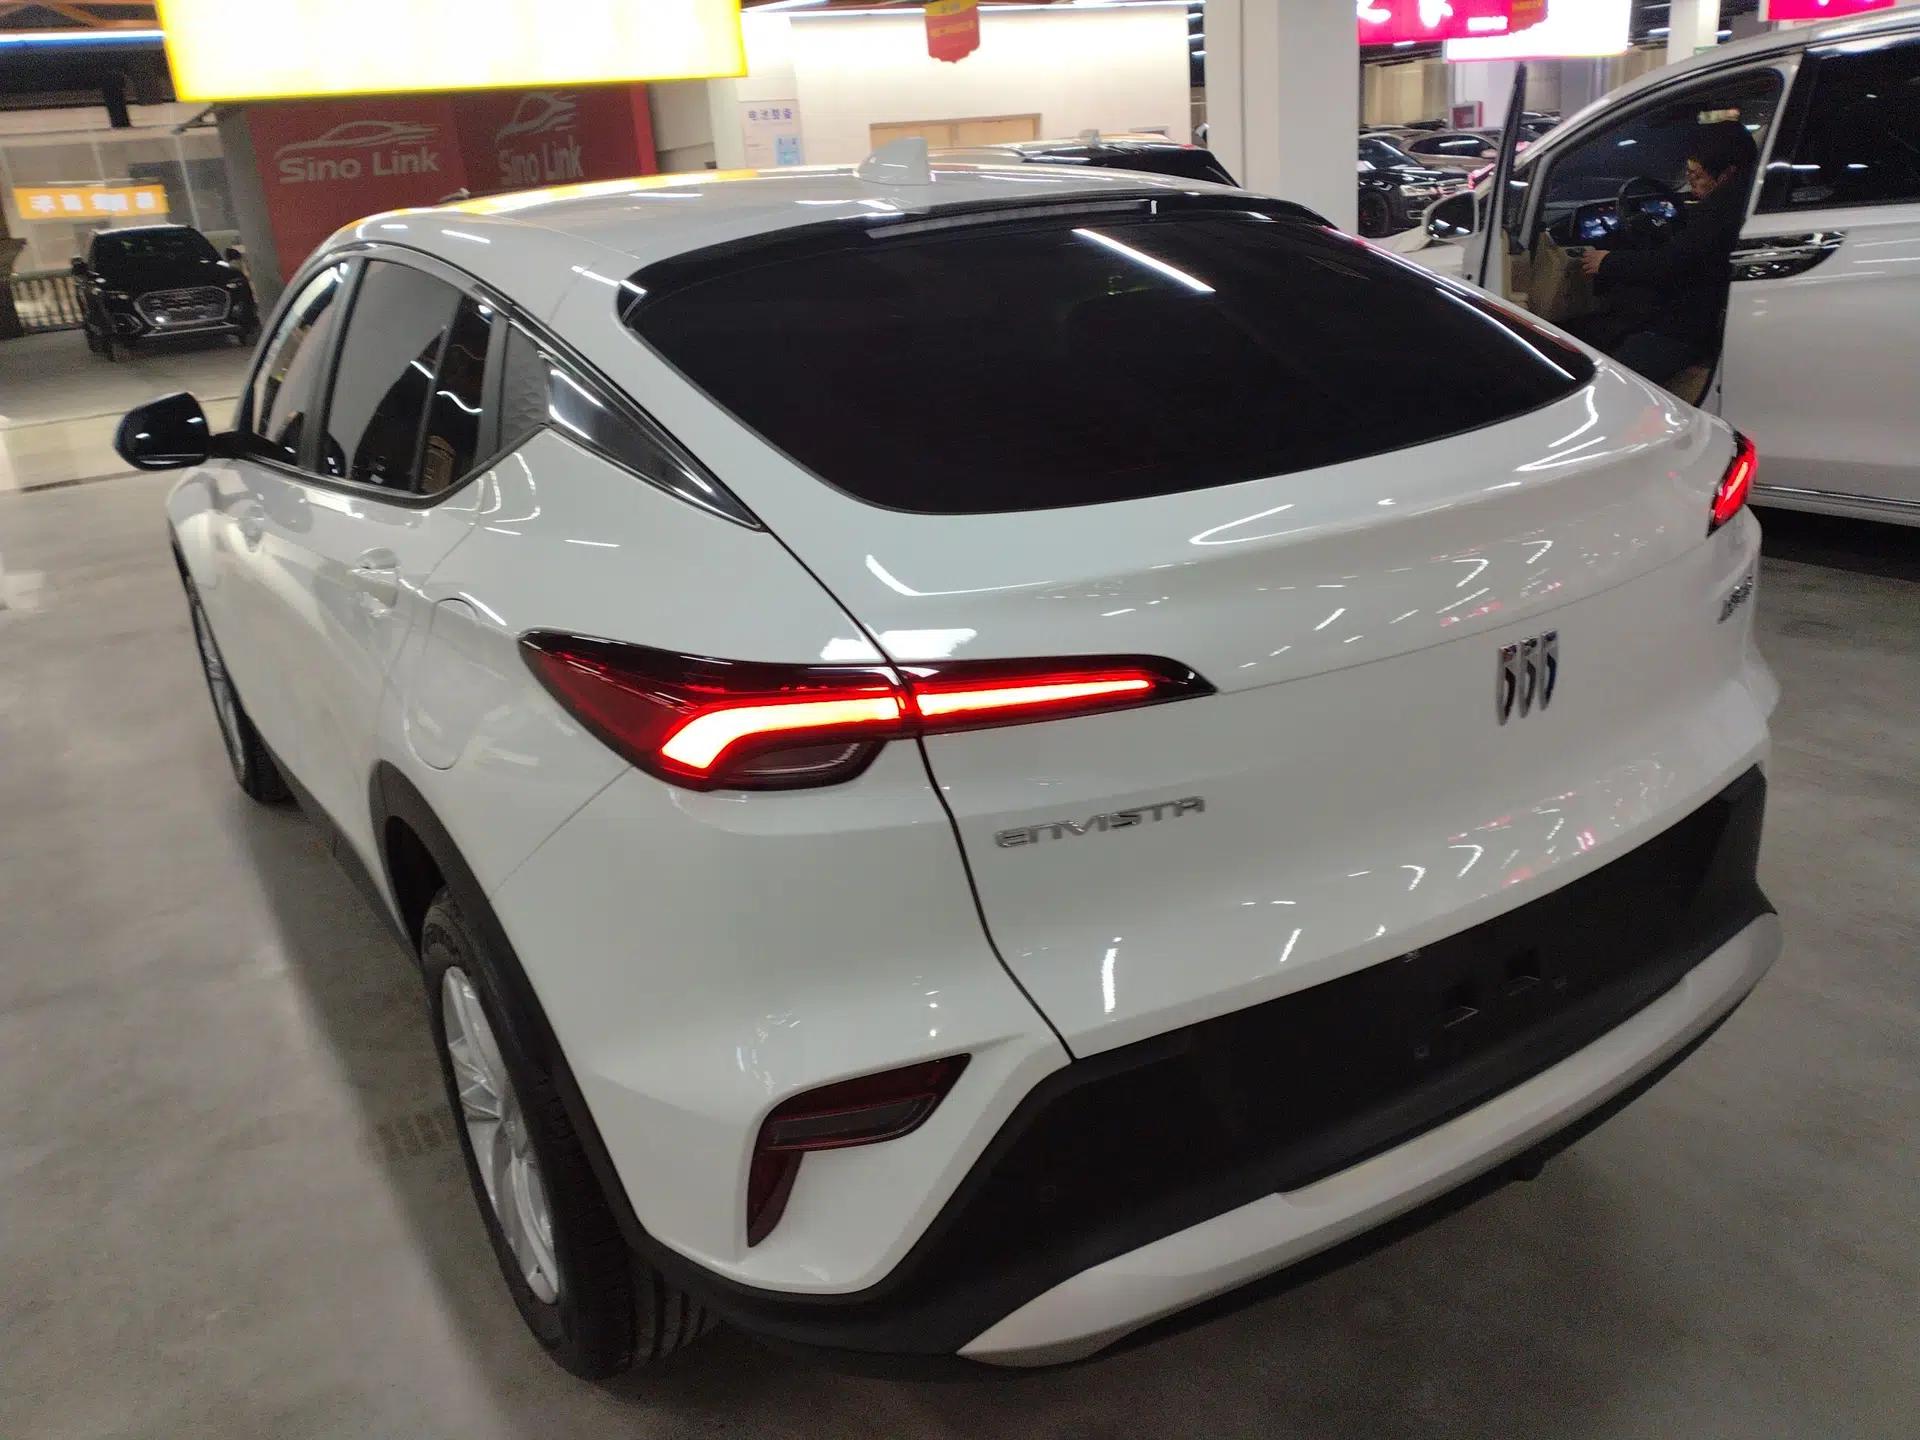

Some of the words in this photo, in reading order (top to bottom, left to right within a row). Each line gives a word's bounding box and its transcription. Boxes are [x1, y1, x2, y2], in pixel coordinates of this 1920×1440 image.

[278, 156, 361, 184] Sino
[372, 147, 441, 177] Link
[500, 149, 540, 185] Sino
[542, 134, 584, 180] Link
